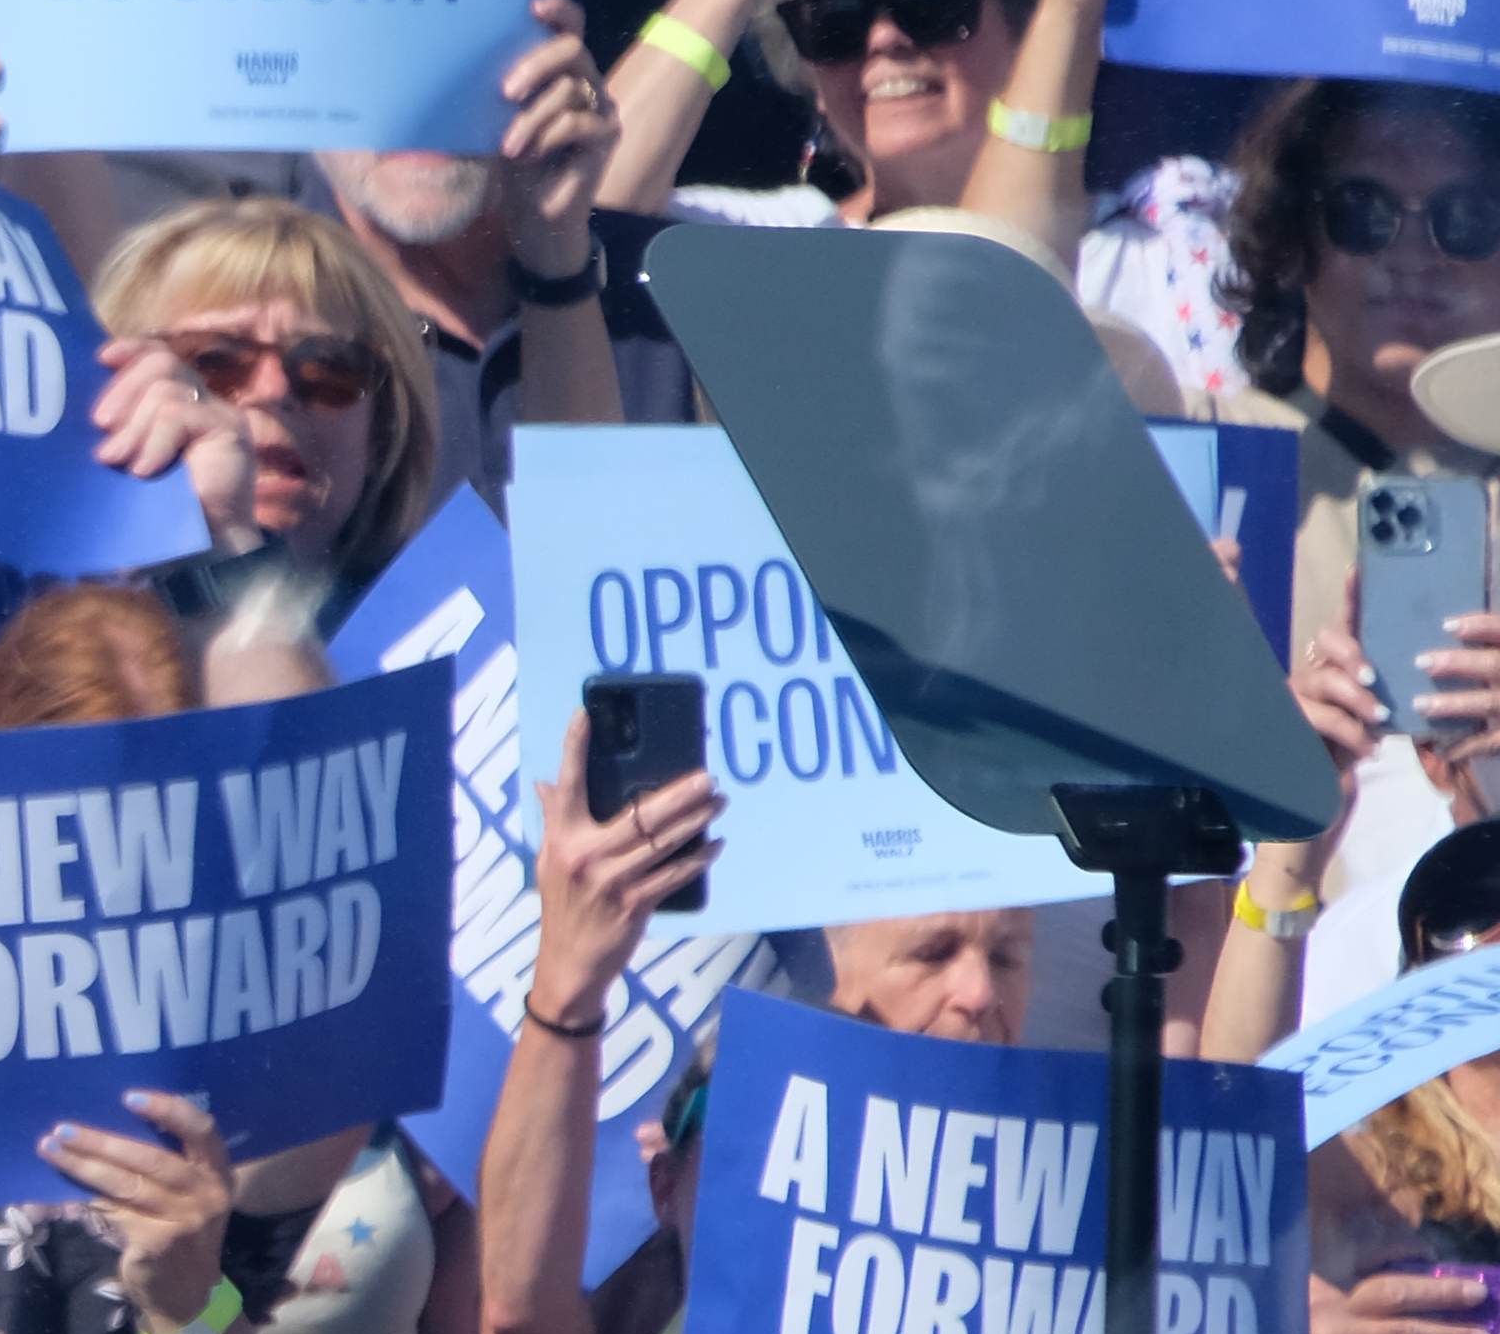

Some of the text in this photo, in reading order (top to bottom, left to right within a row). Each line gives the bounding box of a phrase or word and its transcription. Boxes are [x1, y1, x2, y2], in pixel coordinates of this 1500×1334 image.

[221, 730, 409, 892] WAY
[759, 1073, 828, 1212] A
[851, 1096, 1098, 1256] NEW
